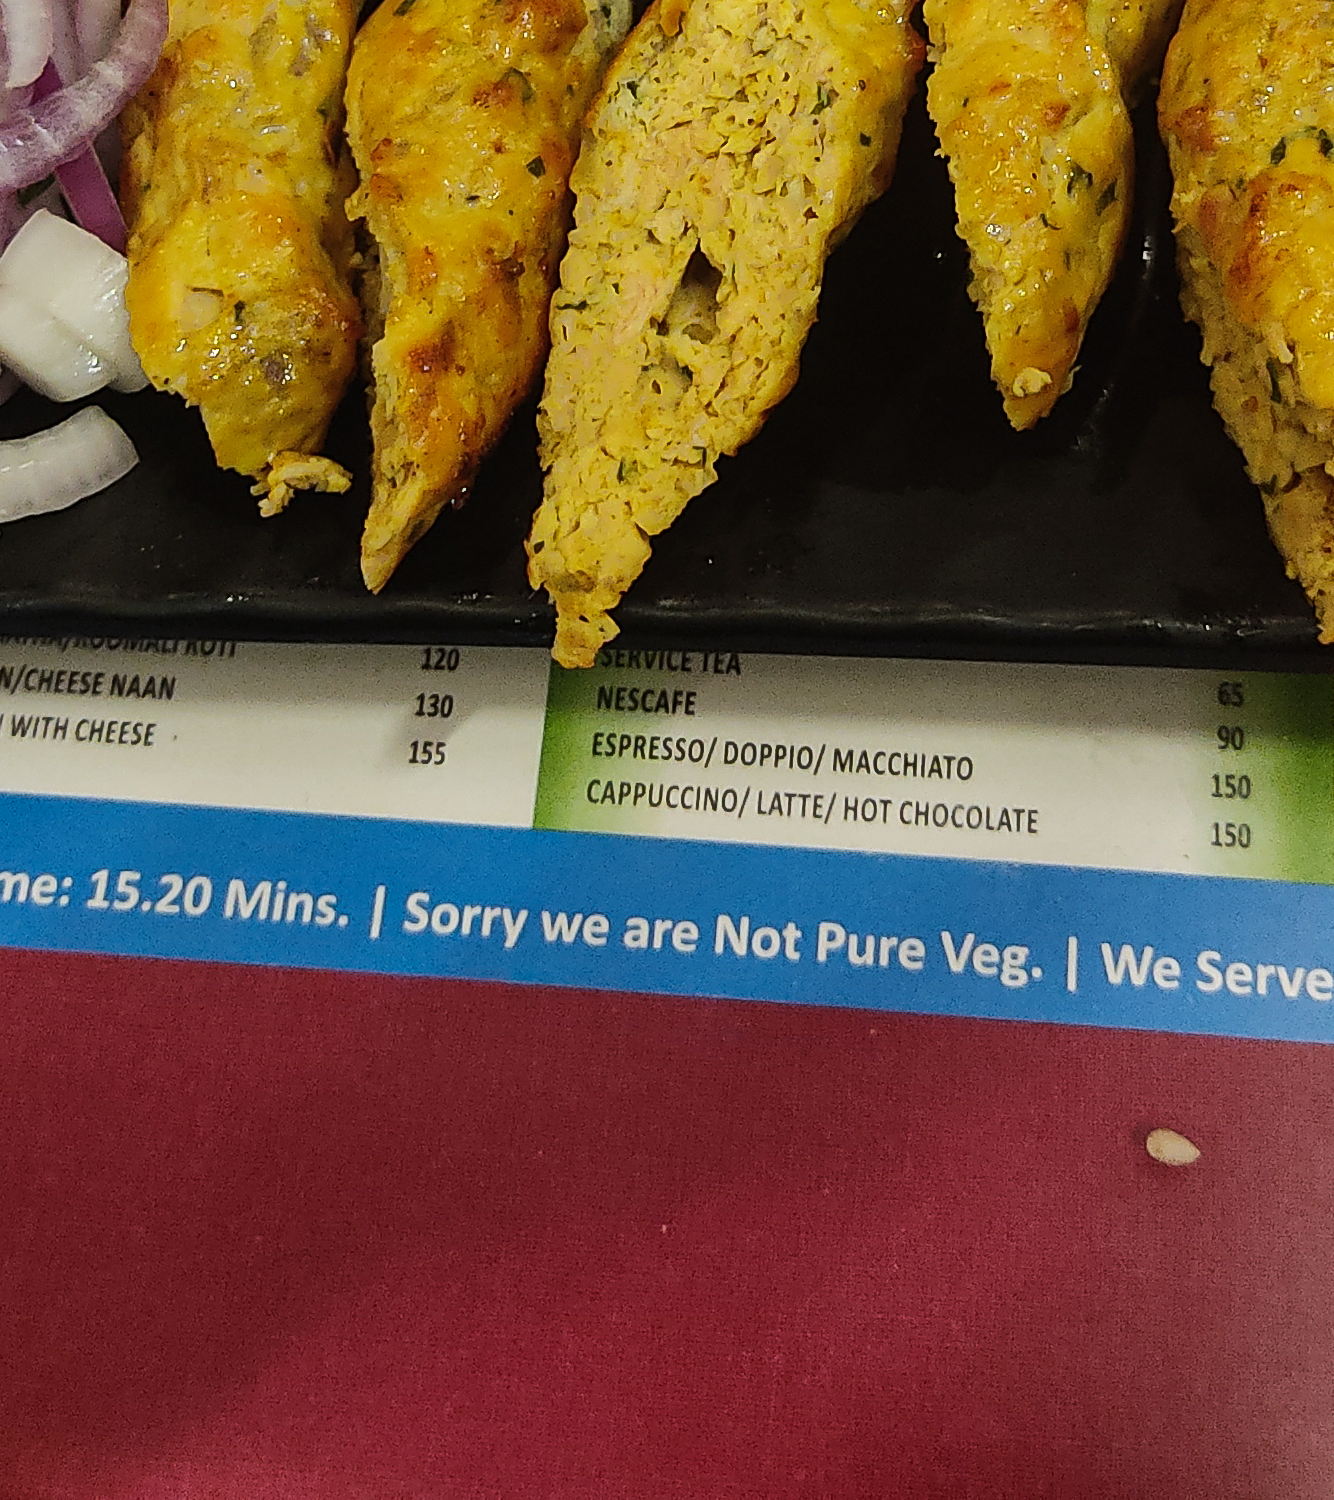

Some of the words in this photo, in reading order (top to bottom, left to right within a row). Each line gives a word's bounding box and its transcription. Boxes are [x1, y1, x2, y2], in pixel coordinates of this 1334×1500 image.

[420, 647, 461, 672] 120
[701, 652, 741, 675] TEA
[110, 673, 176, 700] NAAN
[1218, 682, 1245, 708] 65
[415, 692, 454, 719] 130
[597, 686, 696, 716] NESCAFE
[9, 714, 69, 741] WITH
[75, 717, 158, 747] CHEESE
[1216, 725, 1245, 753] 90
[409, 740, 446, 766] 155
[592, 731, 718, 769] ESPRESSO/
[723, 741, 828, 774] DOPPIO/
[832, 747, 975, 781] MACCHIATO
[1210, 774, 1252, 801] 150
[587, 779, 751, 818] CAPPUCCINO/
[756, 791, 837, 824] LATTE/
[842, 797, 894, 826] HOT
[899, 801, 1040, 834] CHOCOLATE
[1210, 822, 1252, 850] 150
[86, 868, 212, 918] 15.20
[225, 879, 348, 928] Mins.
[403, 891, 528, 949] Sorry
[542, 912, 609, 949] we
[623, 916, 698, 954] are
[714, 914, 803, 963] Not
[817, 923, 925, 972] Pure
[941, 932, 1042, 988] Veg.
[1101, 944, 1180, 990] We
[1196, 951, 1334, 1002] Serve
